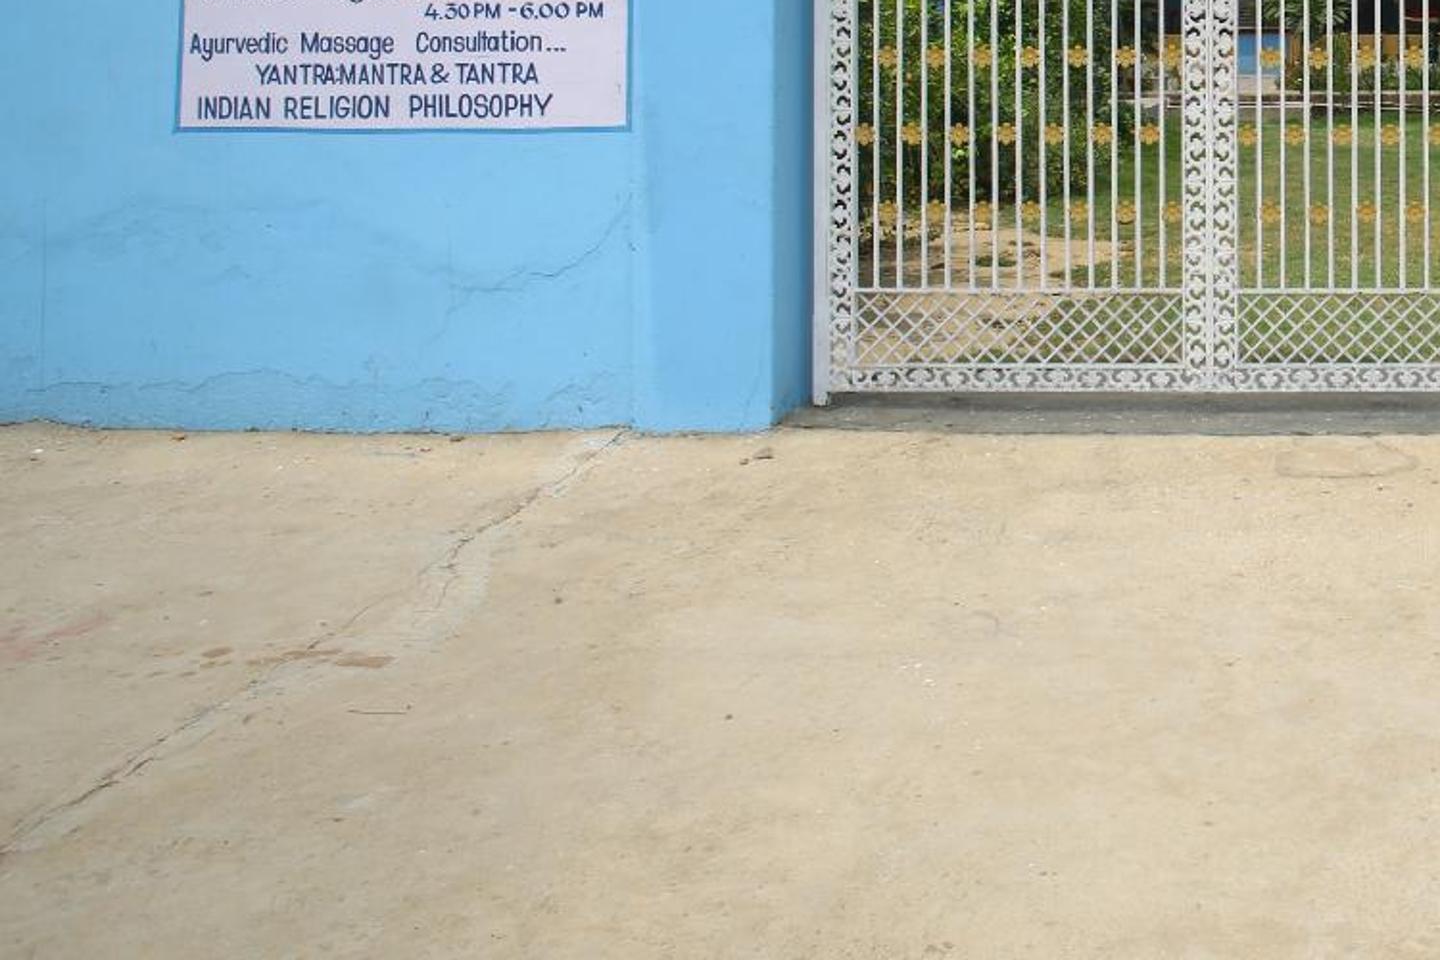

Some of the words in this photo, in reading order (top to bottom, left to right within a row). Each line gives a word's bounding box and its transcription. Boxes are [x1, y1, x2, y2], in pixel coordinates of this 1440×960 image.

[473, 3, 501, 19] PM
[575, 1, 604, 19] PM
[190, 32, 289, 62] Ayurvedic
[300, 32, 395, 61] Massage
[431, 63, 450, 84] &
[455, 62, 538, 84] TANTRA
[198, 96, 271, 120] INDIAN
[283, 96, 389, 119] RELIGION
[409, 93, 553, 118] PHILOSOPHY
